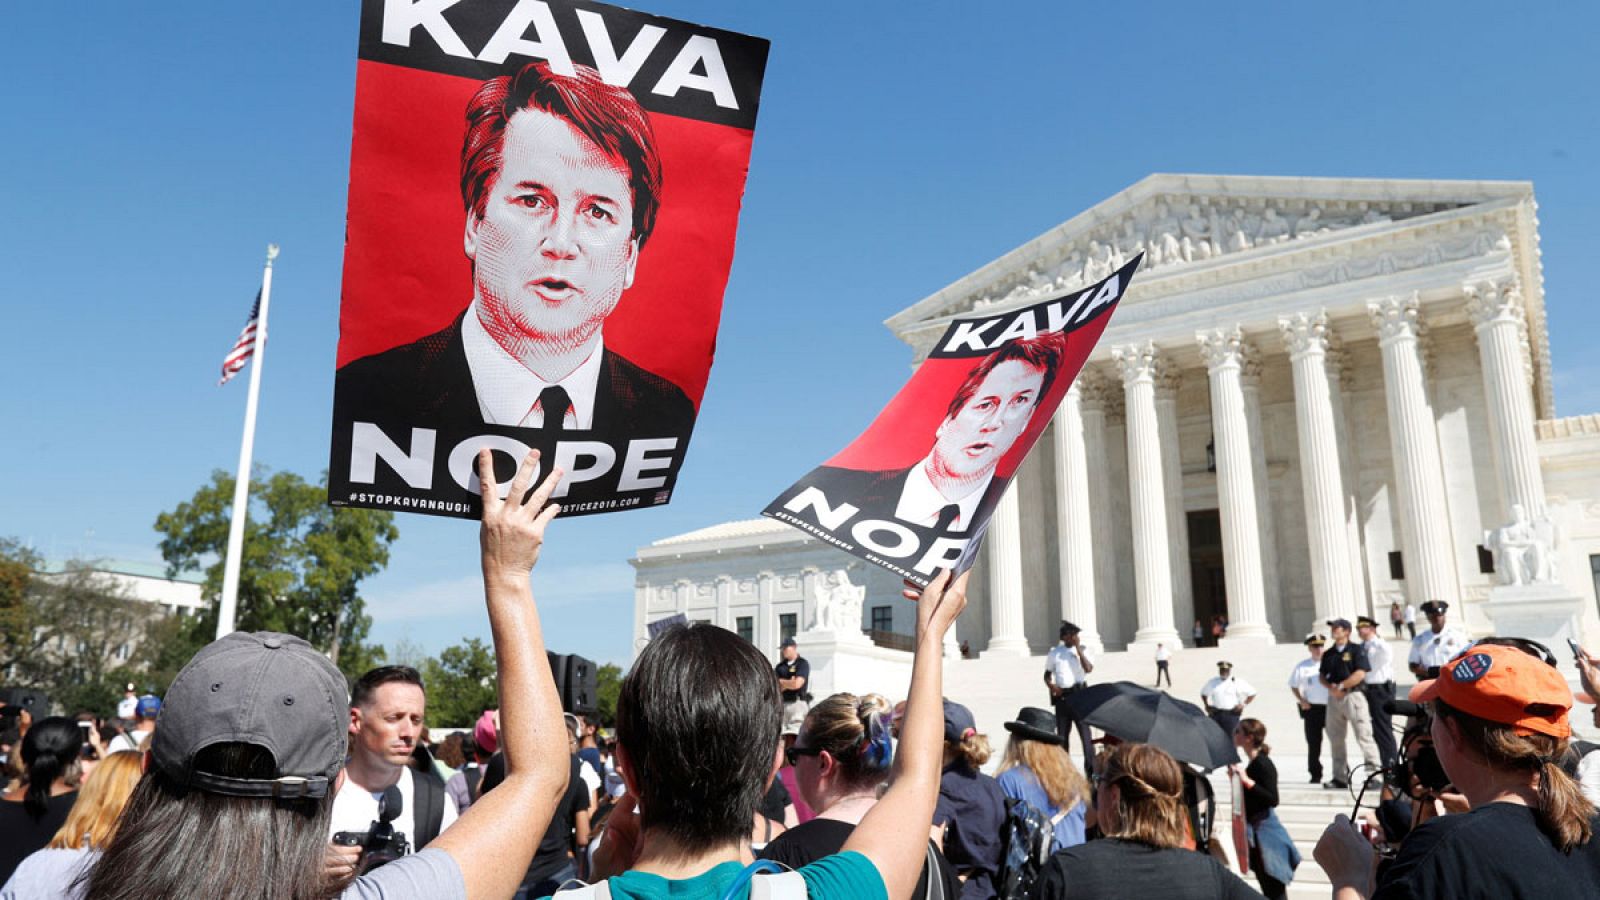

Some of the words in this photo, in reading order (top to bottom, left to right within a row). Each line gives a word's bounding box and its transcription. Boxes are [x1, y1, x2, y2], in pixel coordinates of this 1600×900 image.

[382, 0, 740, 110] KAVA
[942, 273, 1120, 353] KAVA
[349, 421, 678, 499] NOPE
[349, 492, 471, 513] #STOPKAVANAUGH
[784, 486, 982, 577] NOP
